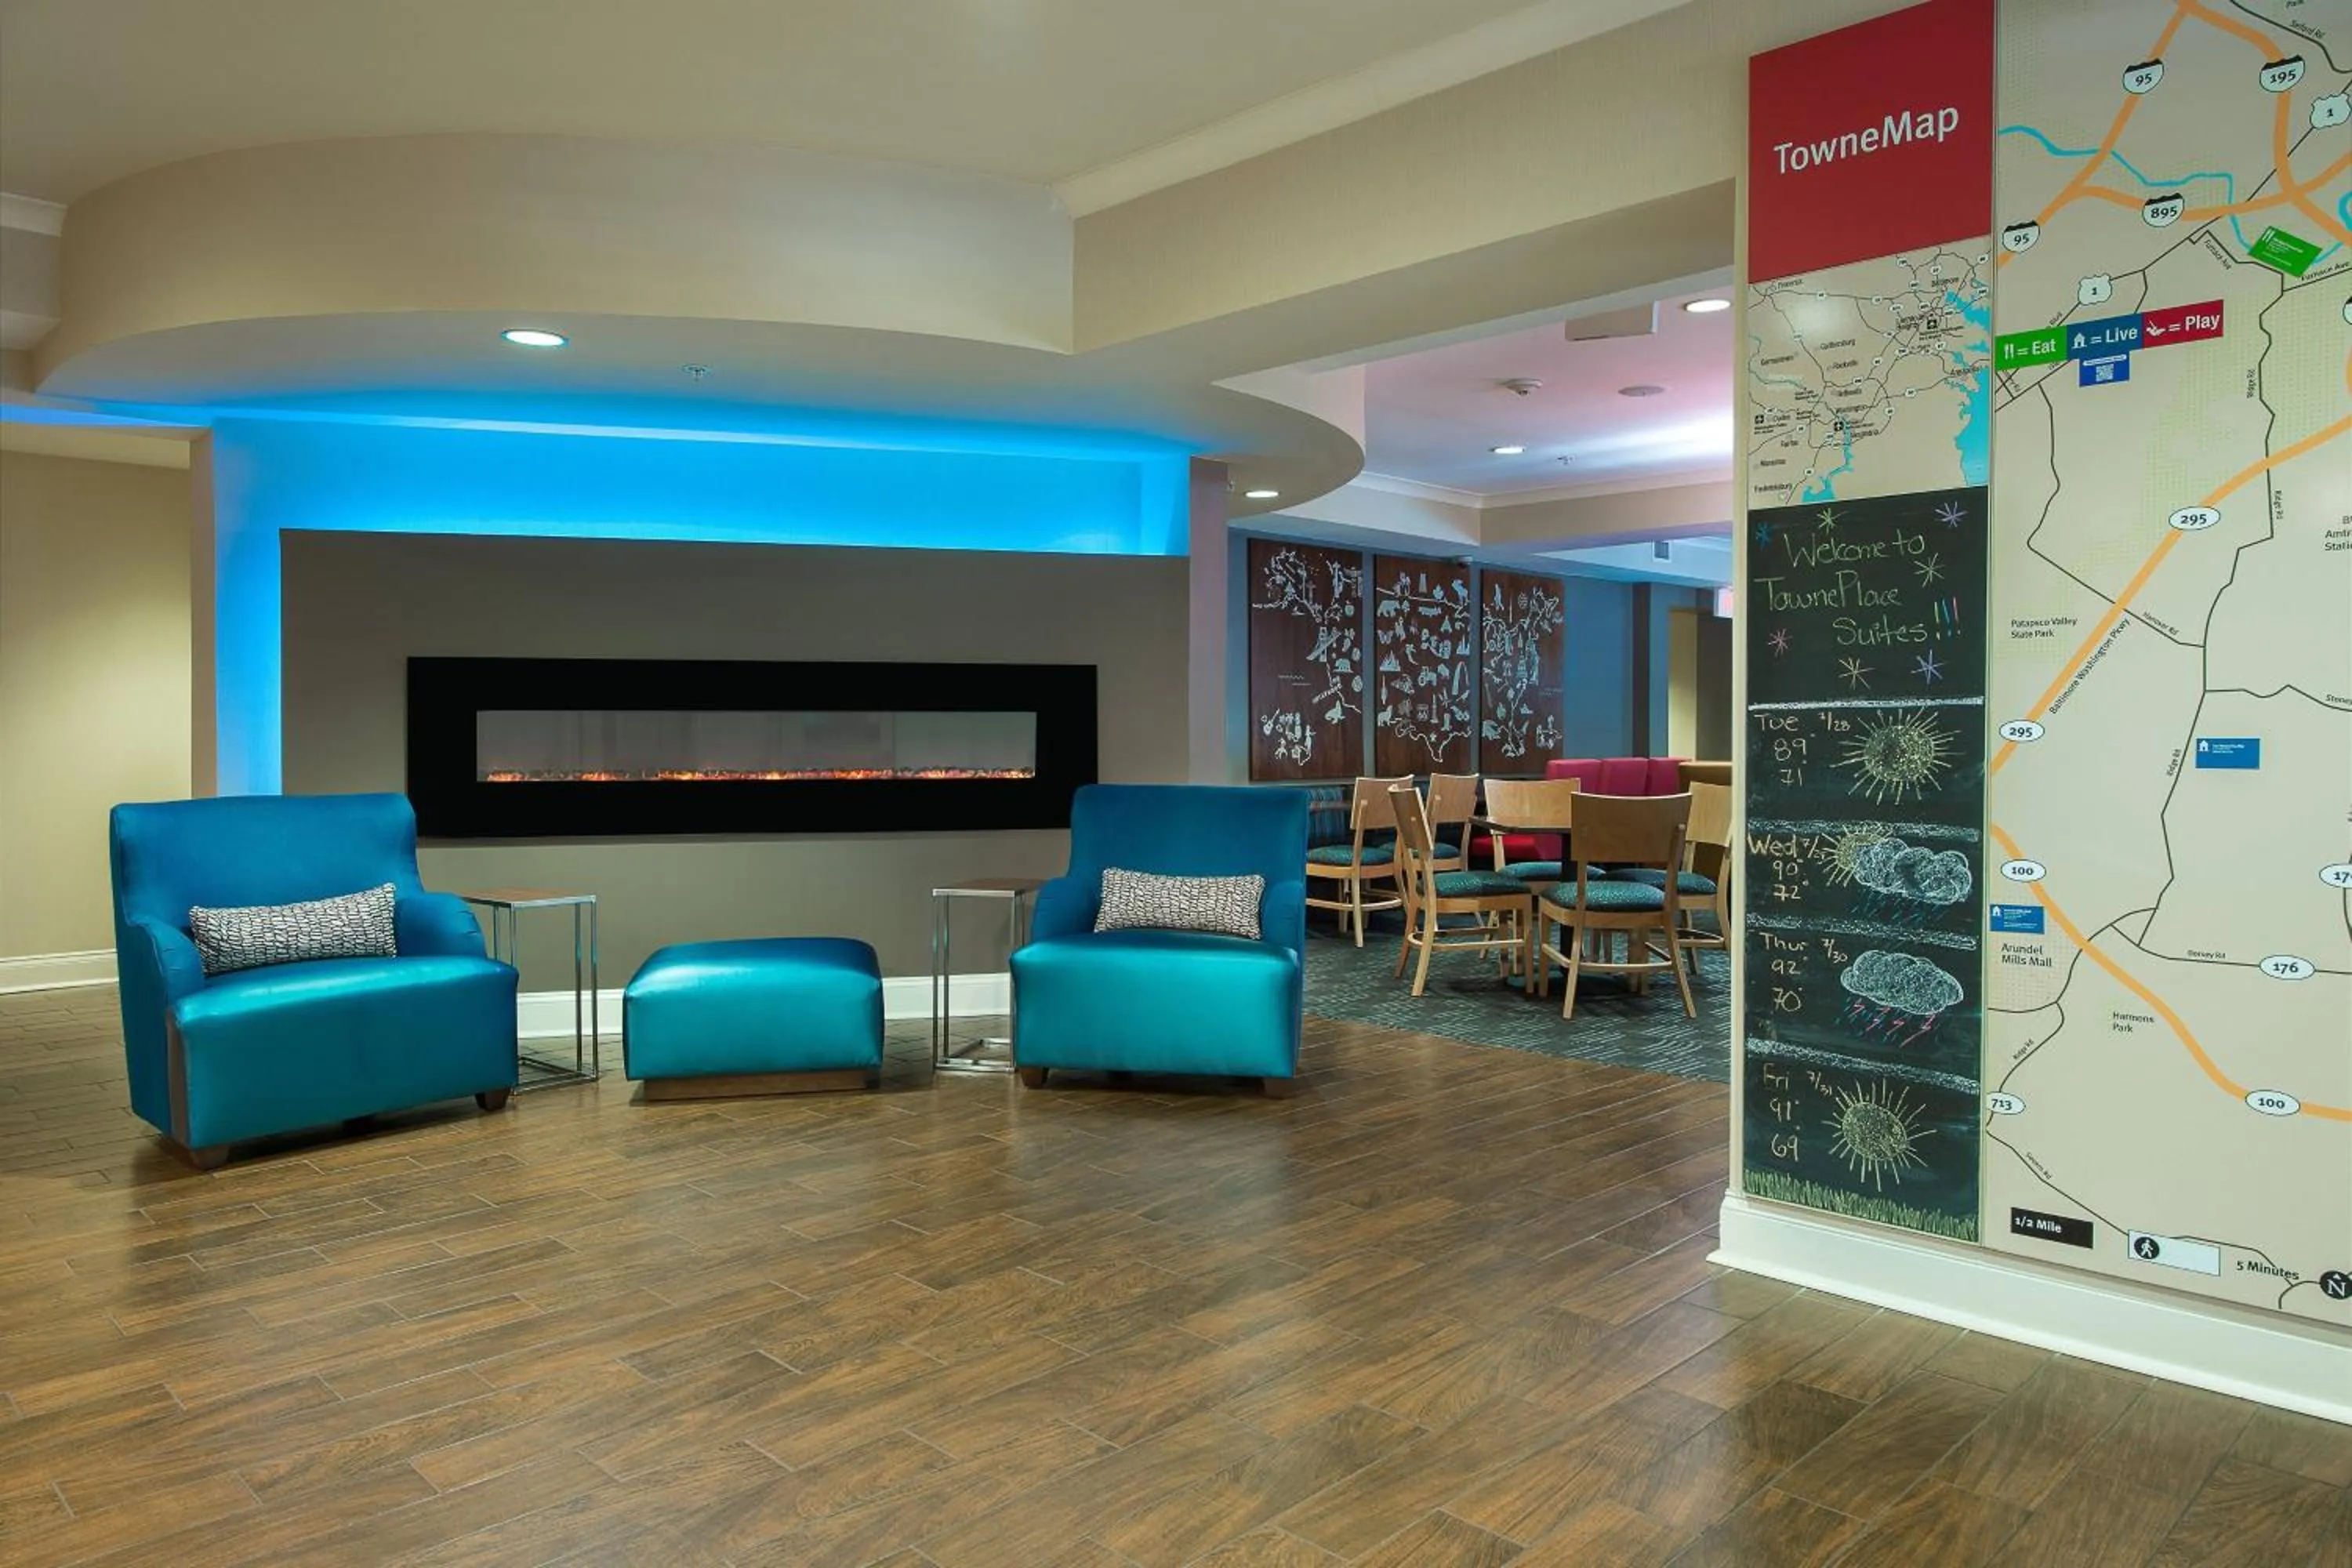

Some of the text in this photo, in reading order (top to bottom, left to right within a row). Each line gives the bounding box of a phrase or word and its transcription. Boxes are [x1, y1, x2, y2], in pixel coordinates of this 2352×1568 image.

[2135, 72, 2152, 85] 95
[2270, 69, 2296, 83] 195
[2326, 108, 2334, 118] 1
[1773, 106, 1959, 174] TowneMap
[2151, 205, 2178, 218] 895
[2014, 233, 2030, 245] 95
[2185, 314, 2220, 332] Play
[2106, 327, 2138, 343] Live
[2032, 339, 2056, 354] Eat
[2180, 514, 2207, 524] 295
[2325, 529, 2352, 539] Amtr
[1784, 528, 1925, 567] Welcome to
[2051, 616, 2078, 627] Valley
[2011, 629, 2055, 639] State Park
[2049, 680, 2079, 714] Baltimore
[2076, 638, 2114, 679] Washington
[1754, 713, 1799, 731] Tue
[2009, 728, 2033, 738] 295
[1747, 833, 1797, 858] Wed
[2012, 866, 2034, 876] 100
[2333, 872, 2352, 883] 17
[2002, 942, 2043, 955] Arundel
[2002, 955, 2053, 967] Mills Mall
[2273, 963, 2299, 974] 176
[2113, 1011, 2154, 1023] Harmons
[2113, 1022, 2133, 1033] Park
[1991, 1098, 2013, 1111] 713
[2258, 1097, 2285, 1109] 100
[2036, 1219, 2063, 1234] Mile
[2237, 1260, 2299, 1280] 5 Minutes
[2327, 1279, 2347, 1298] N
